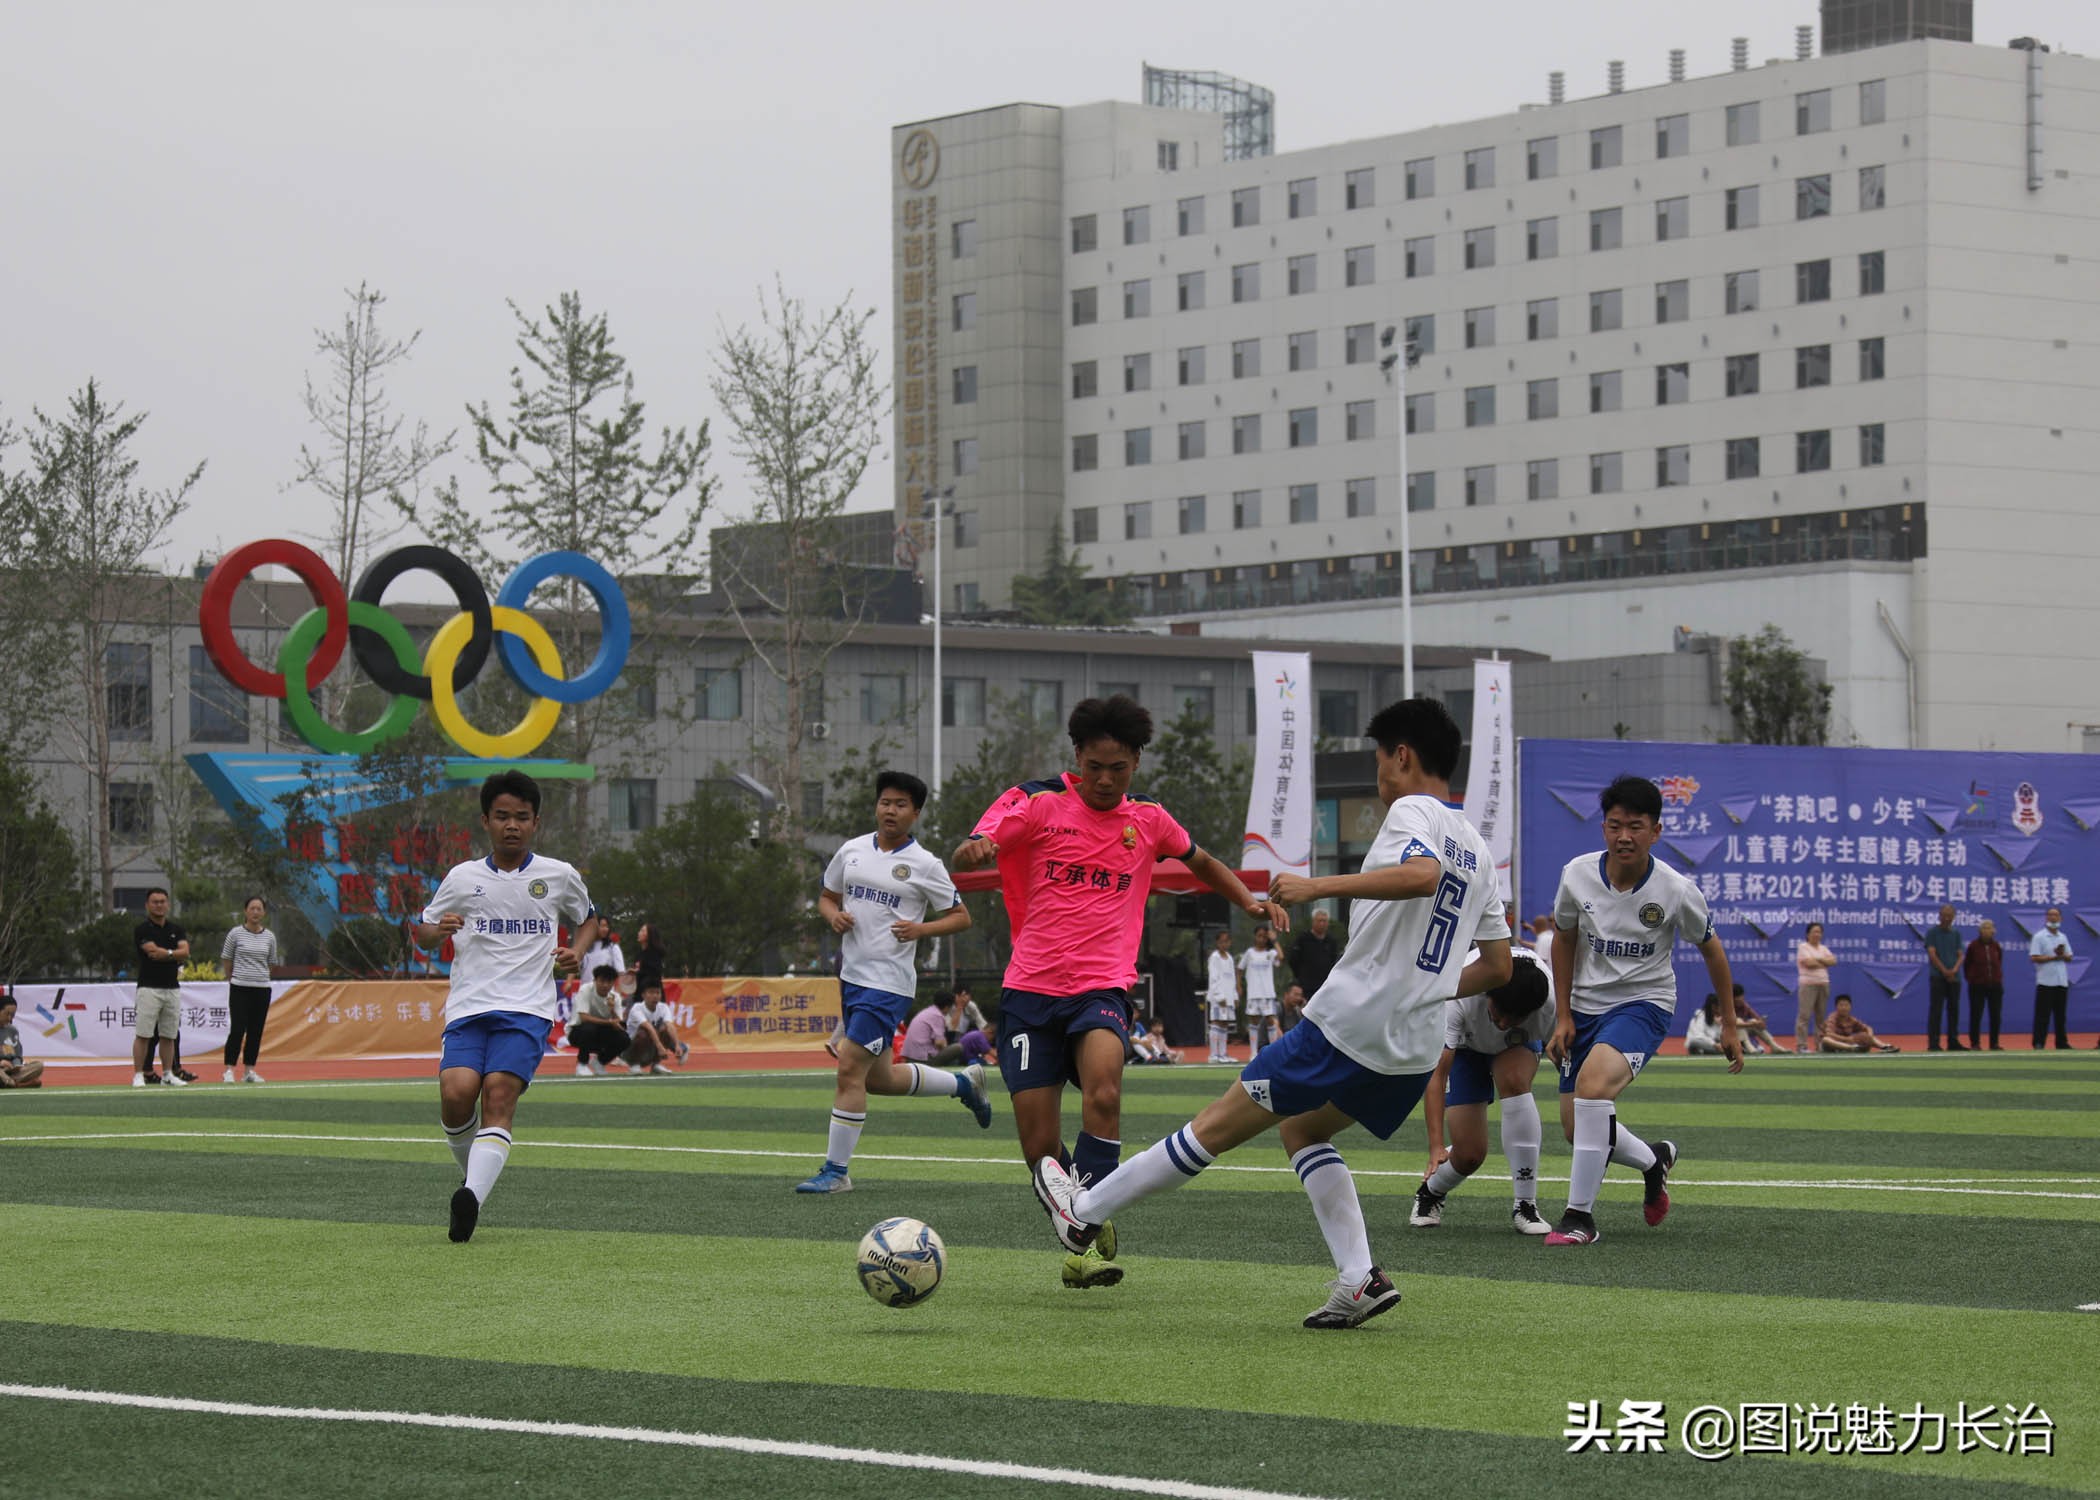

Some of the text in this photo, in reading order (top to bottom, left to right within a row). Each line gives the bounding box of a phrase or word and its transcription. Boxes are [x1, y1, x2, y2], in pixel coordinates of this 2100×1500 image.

[1043, 826, 1079, 836] KELME
[1724, 834, 1967, 866] 儿童青少年主题健身活动
[1045, 860, 1132, 892] 汇承体育
[1416, 871, 1468, 974] 6
[1763, 907, 1788, 923] and
[1828, 909, 1877, 925] themed
[98, 1006, 229, 1029] 中国彩票
[1012, 1033, 1029, 1071] 7
[867, 1249, 909, 1276] molten
